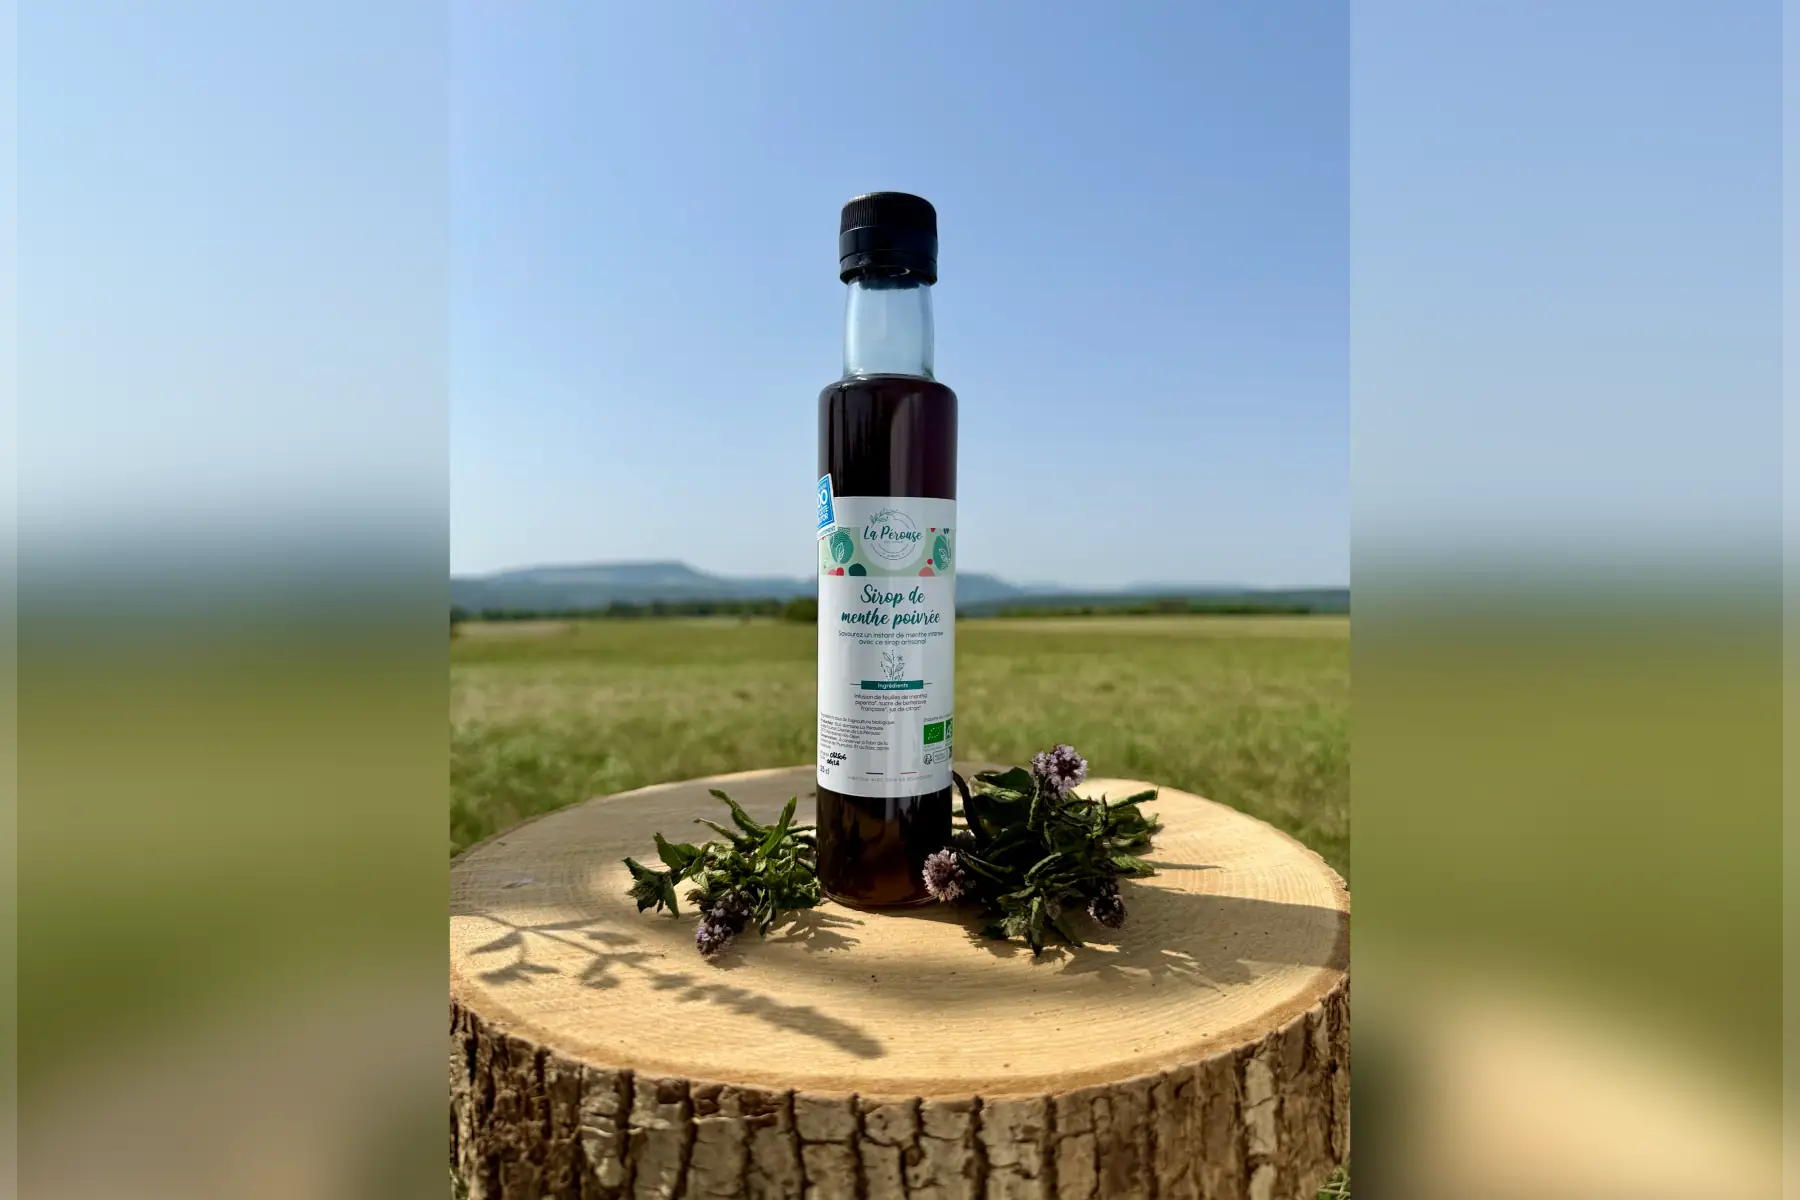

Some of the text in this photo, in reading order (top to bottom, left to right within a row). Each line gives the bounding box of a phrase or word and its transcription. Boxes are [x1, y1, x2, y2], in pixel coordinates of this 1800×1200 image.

[864, 525, 922, 543] La Pérouse
[860, 583, 925, 608] Sirop de
[841, 607, 941, 629] menthe poivrée
[838, 630, 864, 638] Savourez
[877, 682, 909, 690] Ingrédients
